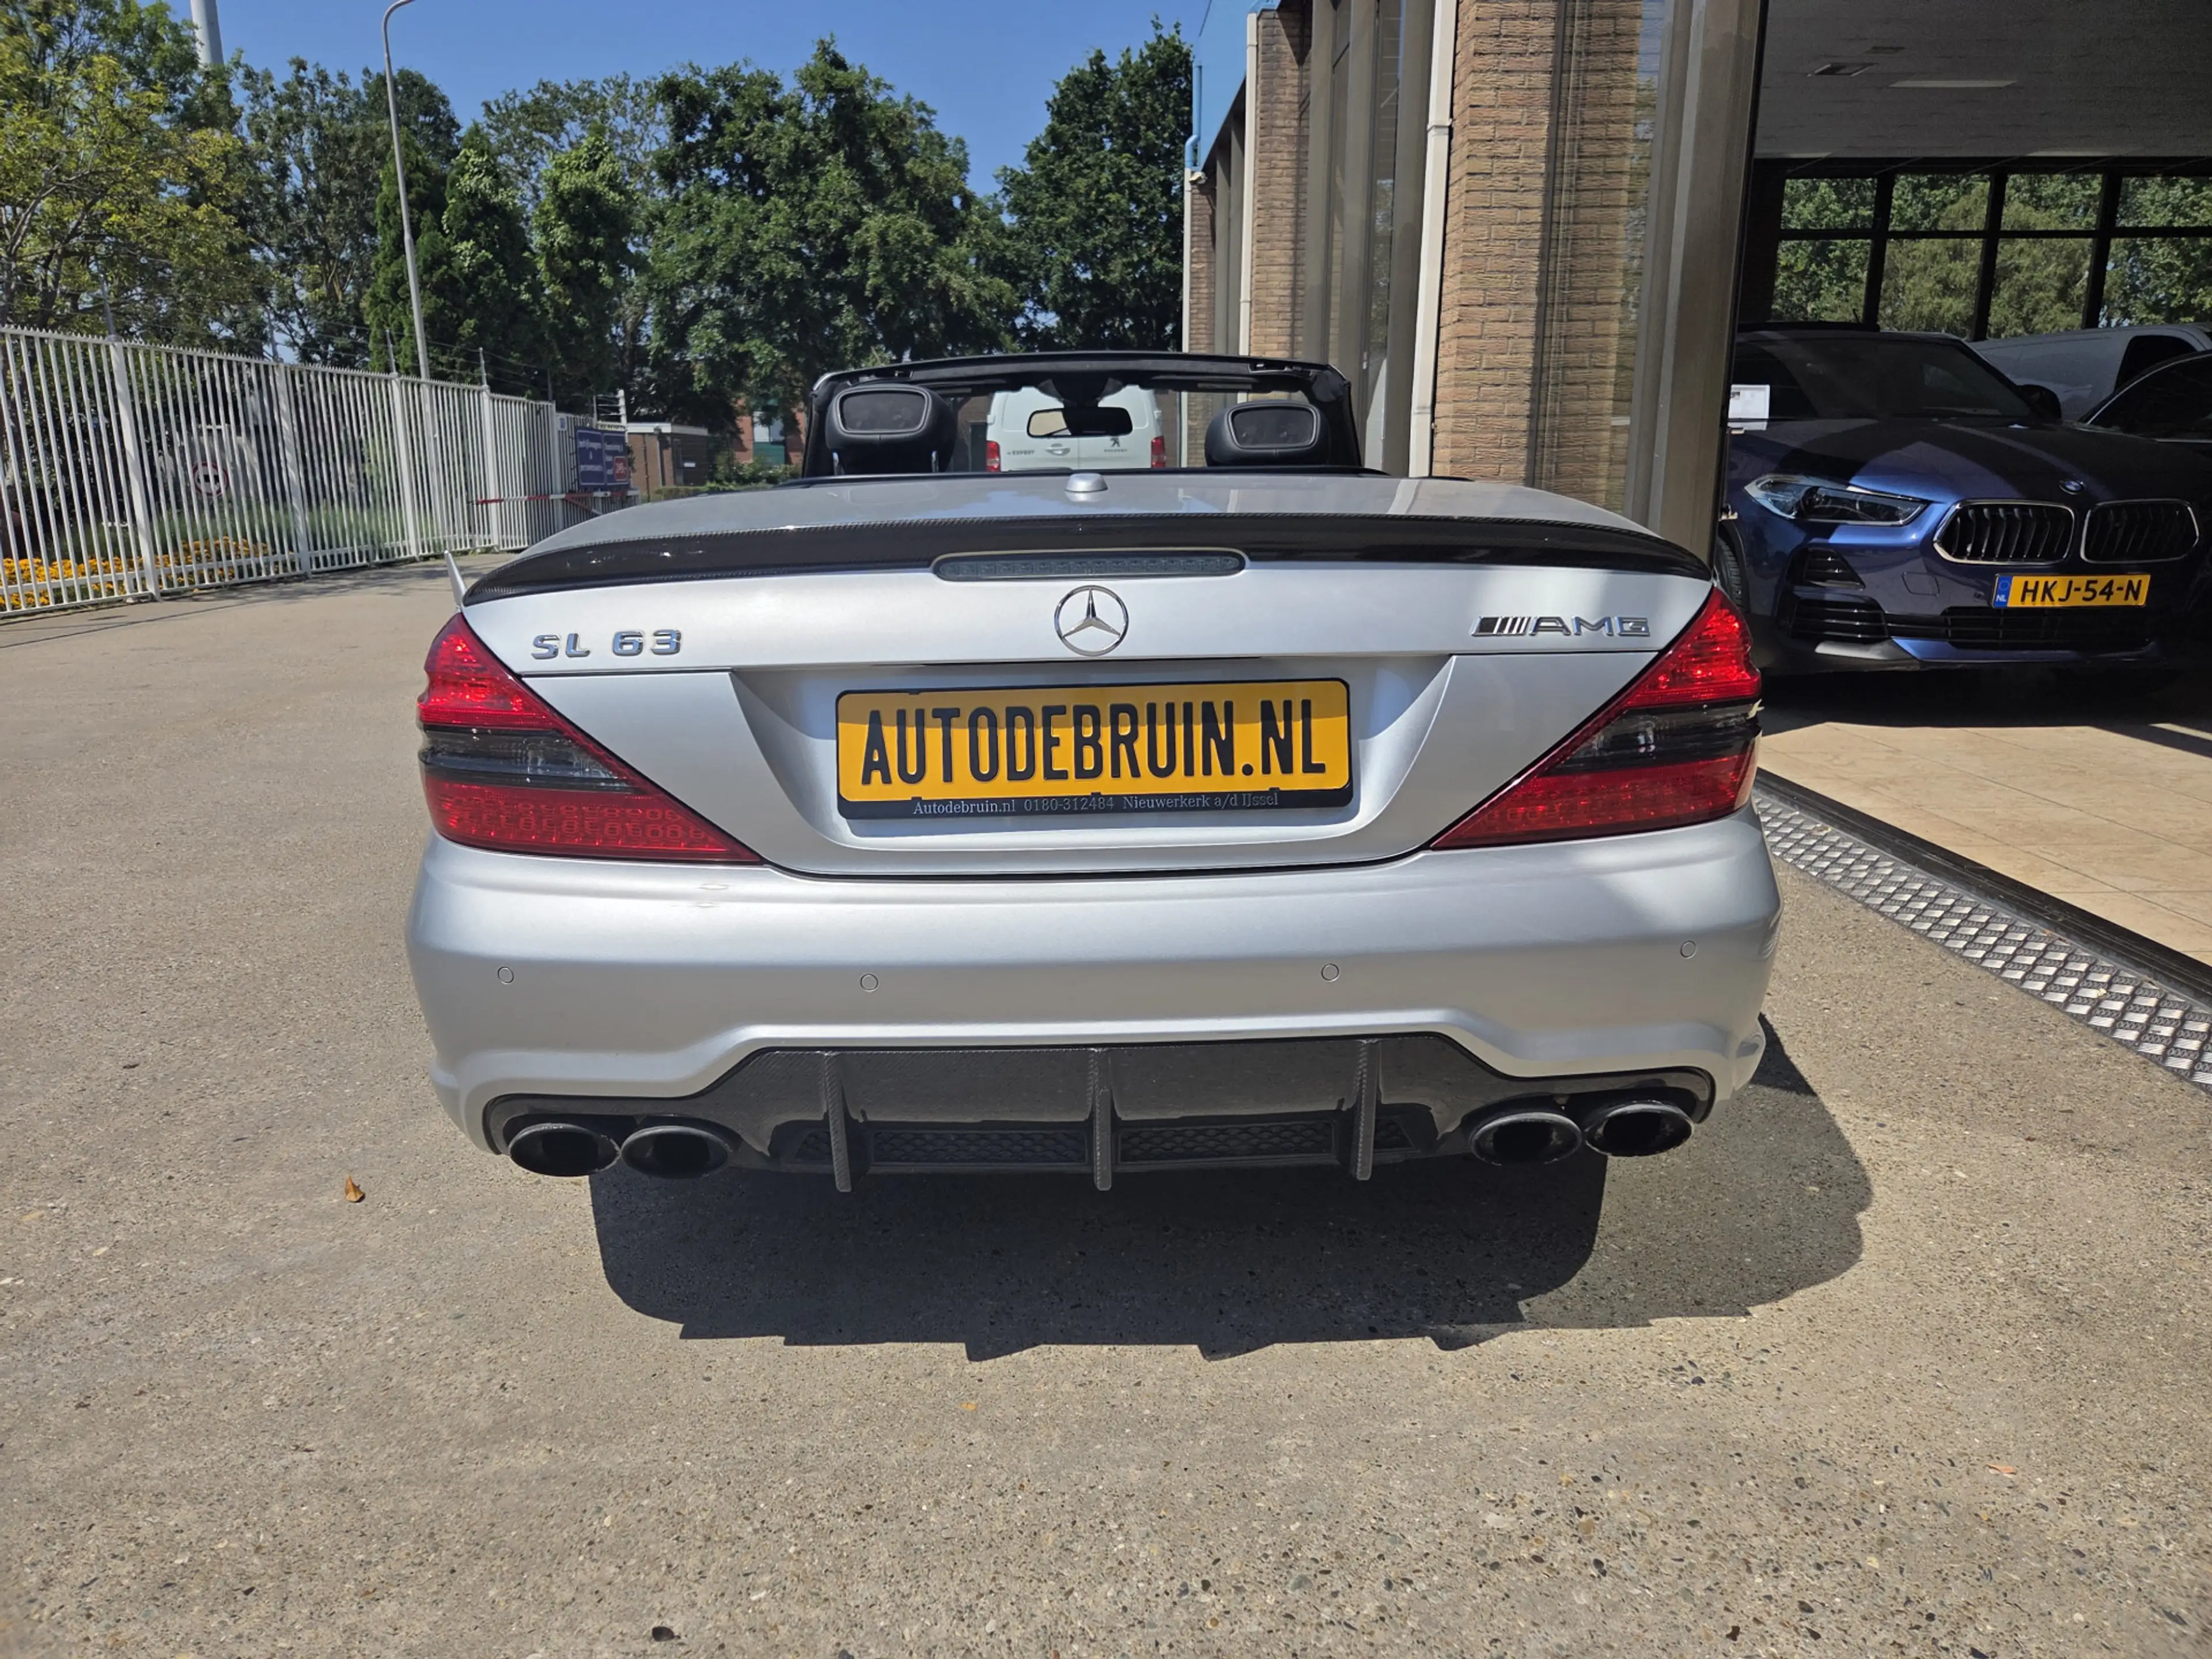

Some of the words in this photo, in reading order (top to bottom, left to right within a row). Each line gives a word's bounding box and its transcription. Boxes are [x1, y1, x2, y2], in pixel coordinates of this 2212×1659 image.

[1995, 594, 2007, 603] NL
[2020, 579, 2142, 603] HKJ-54-N
[1528, 616, 1651, 637] AMG
[531, 632, 591, 660] SL
[612, 628, 682, 657] 63
[861, 698, 1326, 785] AUTODEBRUIN.NL
[912, 799, 1016, 815] Autodebruin.nl
[1024, 797, 1115, 812] 0180-312484
[1123, 794, 1210, 809] Nieuwerkerk
[1214, 793, 1238, 809] a/d
[1241, 792, 1279, 807] IJssel
